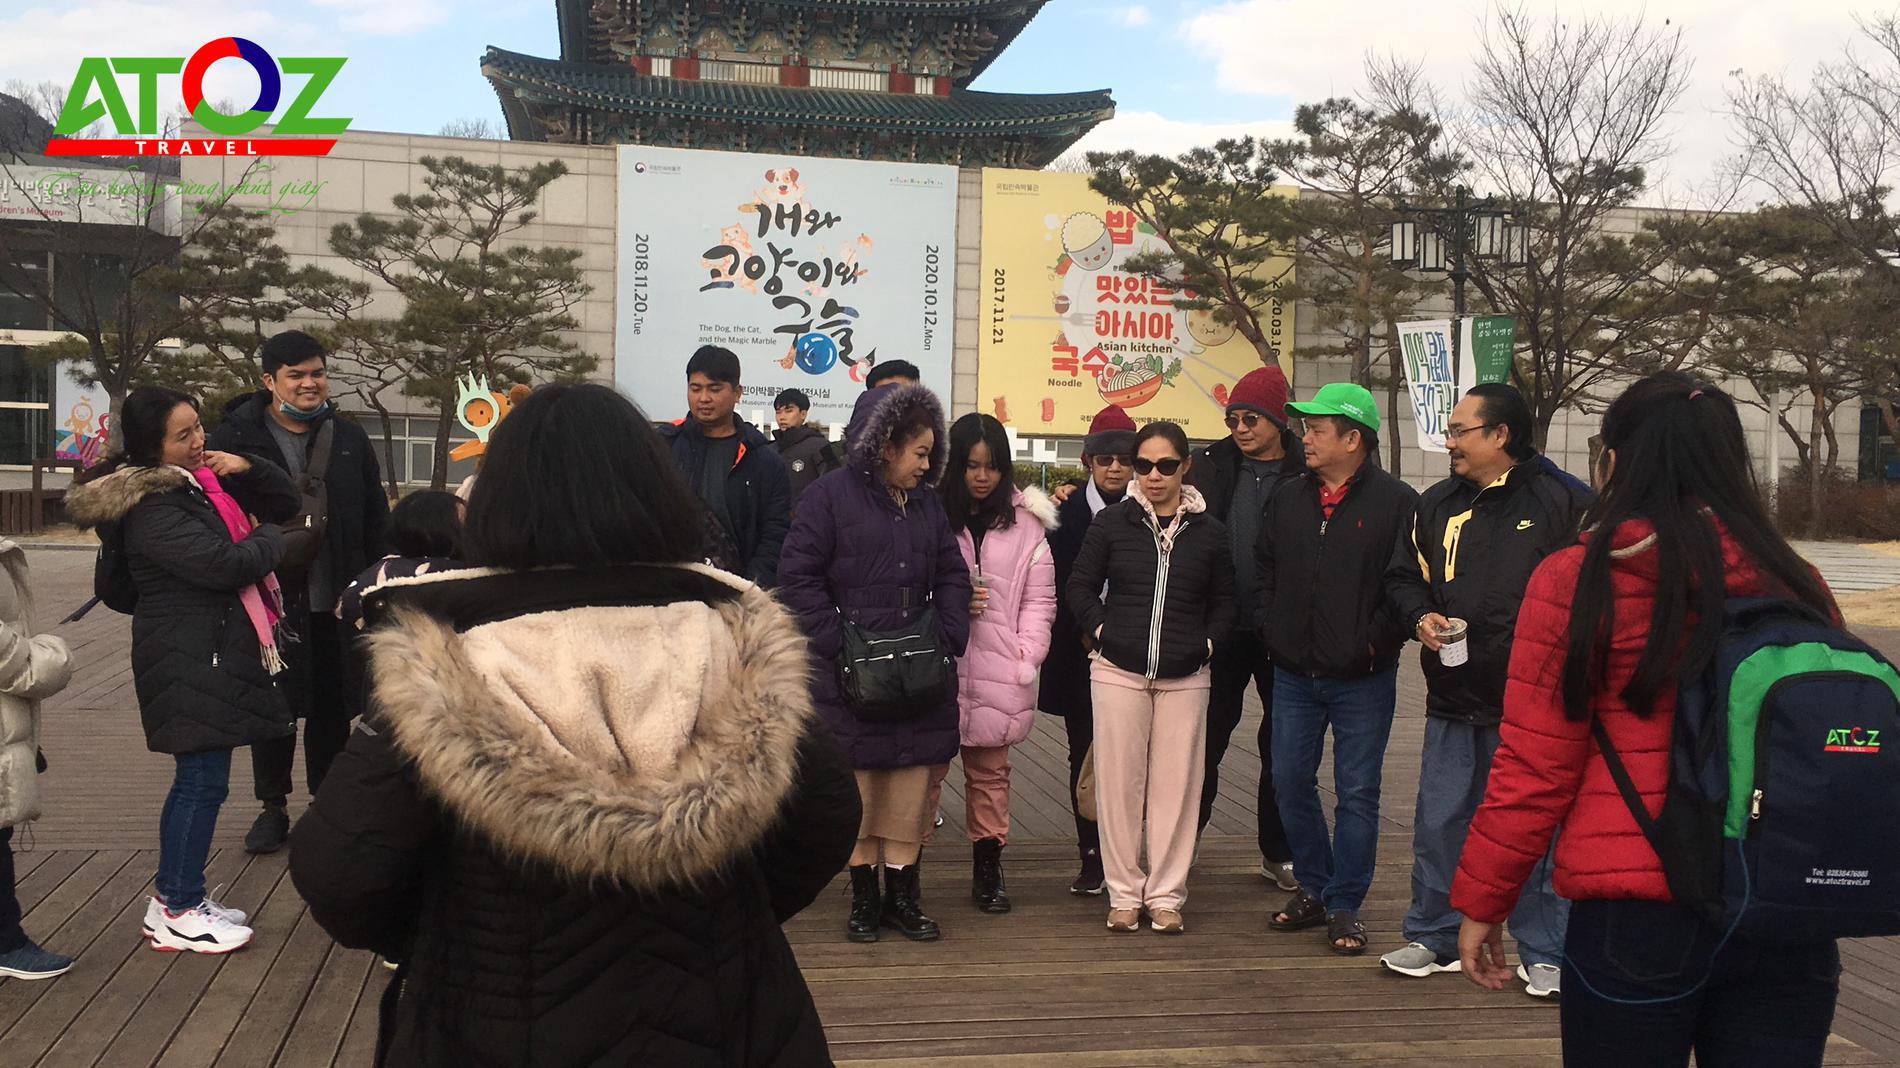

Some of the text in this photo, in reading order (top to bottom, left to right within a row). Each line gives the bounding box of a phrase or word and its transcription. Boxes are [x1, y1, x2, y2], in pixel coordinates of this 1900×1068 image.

[26, 207, 64, 217] Mueum
[1106, 210, 1136, 245] 밥
[699, 243, 867, 295] 고양이와
[1096, 276, 1174, 306] 맛있는
[993, 268, 1006, 345] 2017.11.21
[699, 324, 761, 334] The Dog, the Cat,
[728, 336, 750, 344] Magic
[751, 337, 777, 345] Marble
[1096, 341, 1173, 353] Asian kitchen
[1051, 346, 1109, 378] 국수
[1047, 378, 1082, 388] Noodle
